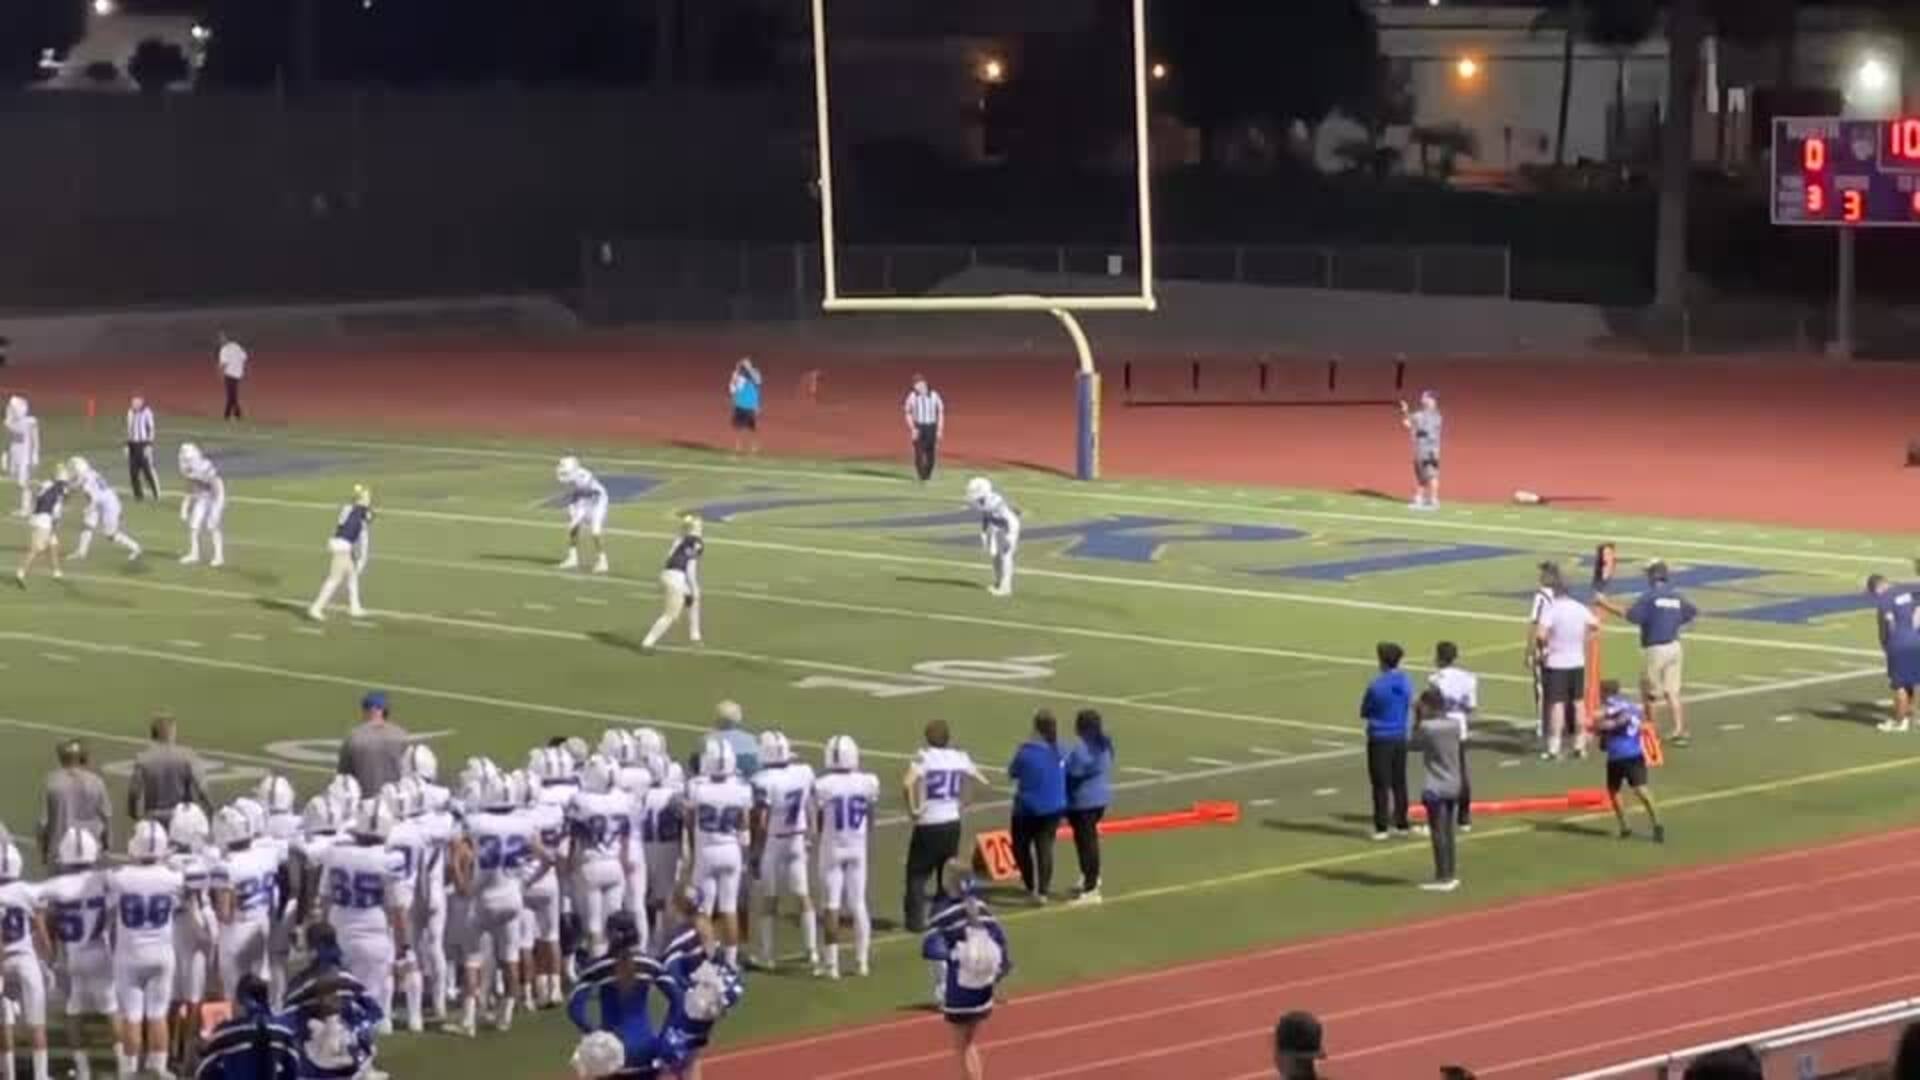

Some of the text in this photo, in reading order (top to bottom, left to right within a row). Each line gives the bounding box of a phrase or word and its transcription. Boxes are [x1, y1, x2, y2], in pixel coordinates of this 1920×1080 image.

[1805, 138, 1825, 171] 0
[1807, 185, 1822, 211] 3
[1843, 190, 1861, 220] 3
